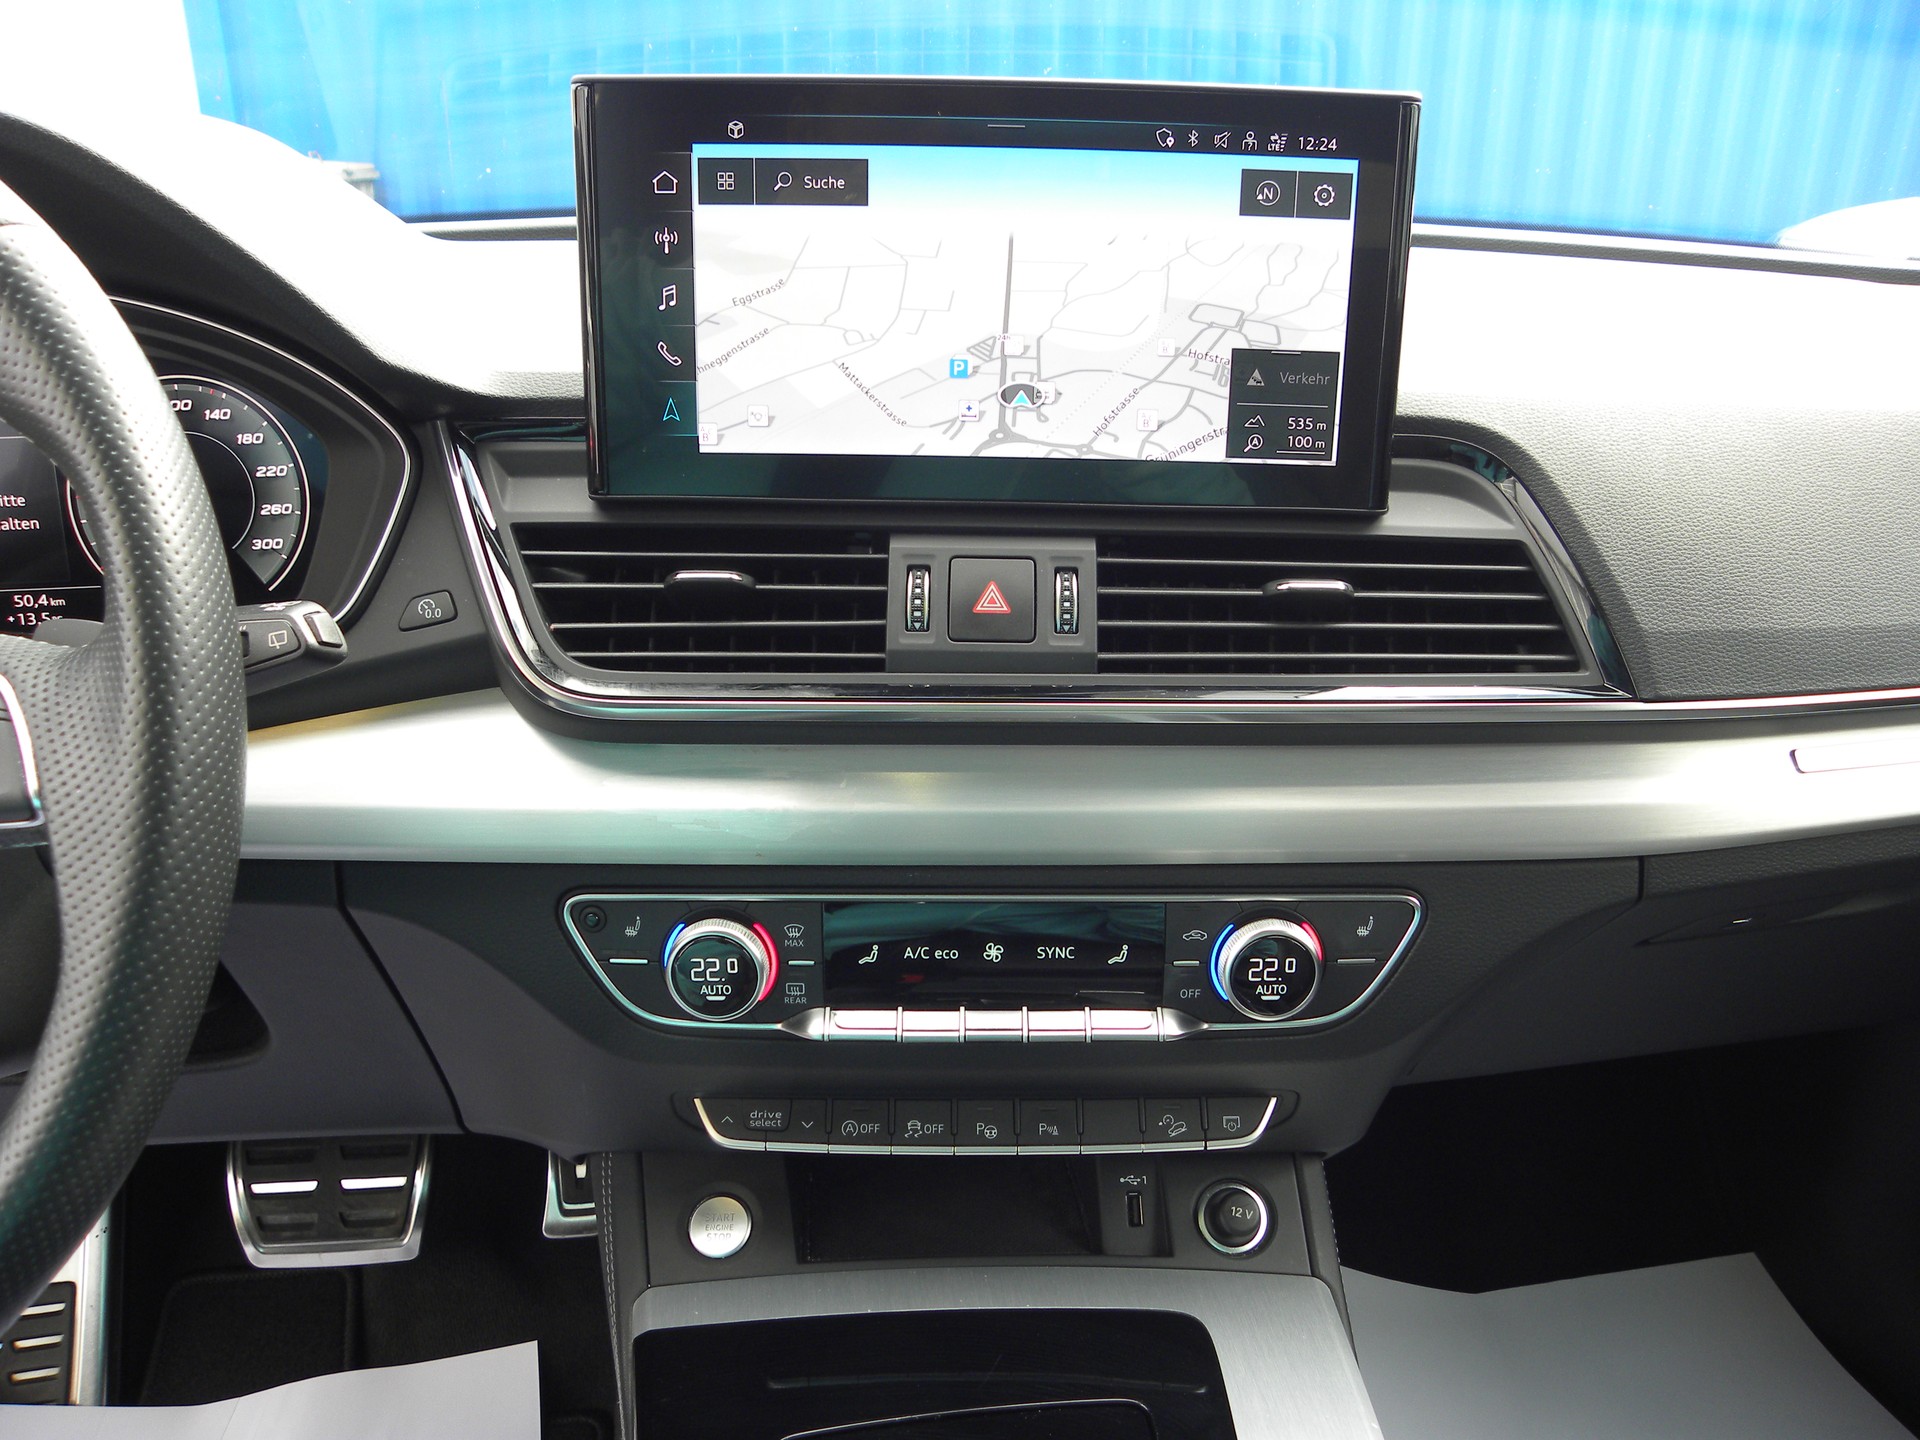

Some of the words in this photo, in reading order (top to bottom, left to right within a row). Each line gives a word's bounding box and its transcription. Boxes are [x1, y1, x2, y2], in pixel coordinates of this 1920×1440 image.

[1267, 143, 1280, 151] LTE
[1298, 136, 1337, 151] 12:24
[803, 175, 846, 190] Suche
[731, 277, 786, 308] Eggstrasse
[696, 327, 770, 376] hneggenstrasse
[953, 361, 965, 375] P
[1279, 371, 1330, 385] Verkehr
[838, 362, 908, 427] Mattackerstrasse
[170, 399, 193, 412] 00
[203, 408, 231, 421] 140
[1093, 387, 1140, 438] Hofstrasse
[1287, 417, 1314, 430] 535
[1316, 422, 1327, 431] m
[236, 432, 264, 445] 180
[1287, 435, 1313, 448] 100
[1315, 441, 1326, 449] m
[255, 465, 288, 478] 220
[260, 503, 293, 516] 260
[0, 517, 40, 530] alten
[251, 538, 284, 551] 300
[425, 608, 442, 619] 0.0
[785, 939, 804, 947] MAX
[903, 946, 931, 960] A/C
[934, 948, 959, 960] eco
[1036, 946, 1075, 960] SYNC
[700, 984, 732, 996] AUTO
[1179, 989, 1201, 999] OFF
[1255, 984, 1287, 996] AUTO
[784, 996, 807, 1005] REAR
[749, 1110, 782, 1119] drive
[749, 1118, 782, 1128] select
[859, 1123, 881, 1134] OFF
[923, 1123, 945, 1134] OFF
[1141, 1175, 1147, 1185] 1
[705, 1212, 736, 1222] START
[1230, 1206, 1244, 1218] 12
[1244, 1210, 1255, 1220] V
[704, 1223, 735, 1232] ENGINE
